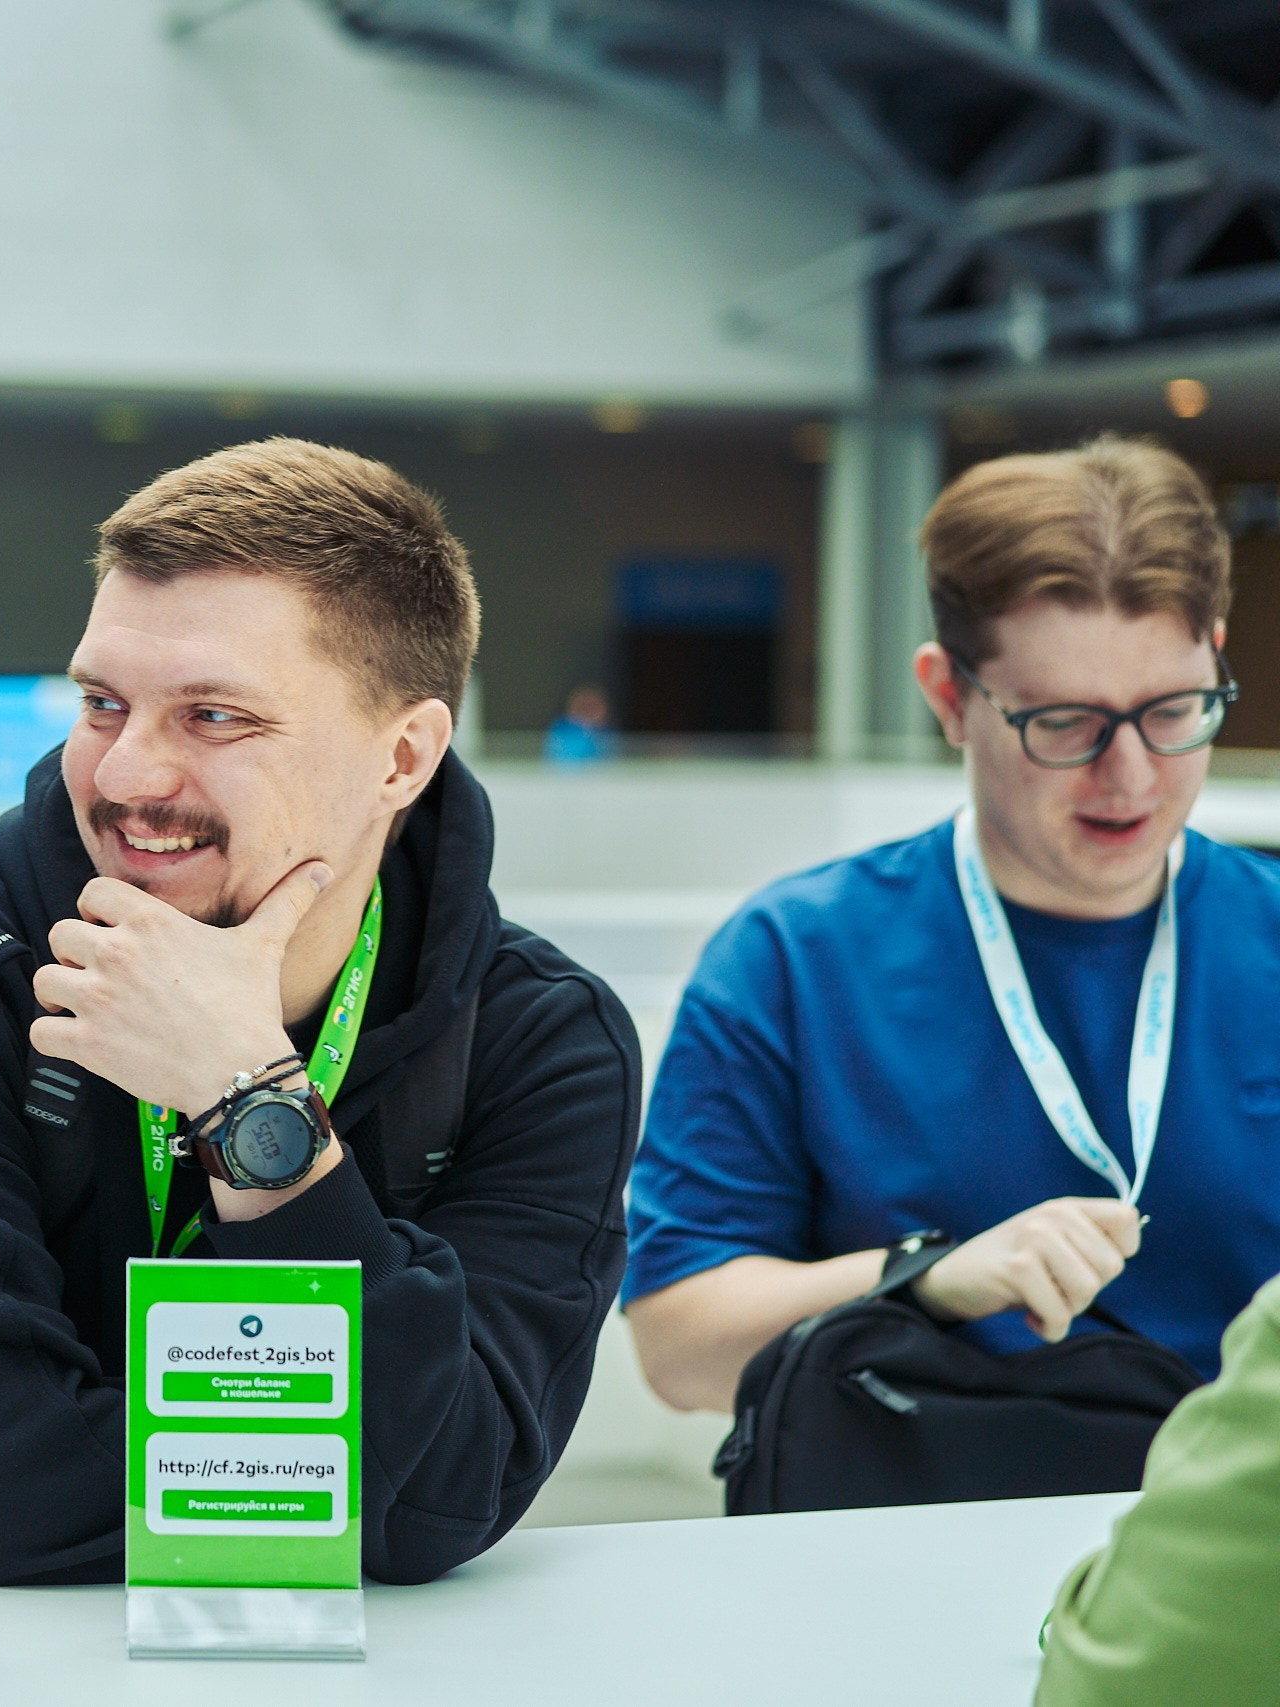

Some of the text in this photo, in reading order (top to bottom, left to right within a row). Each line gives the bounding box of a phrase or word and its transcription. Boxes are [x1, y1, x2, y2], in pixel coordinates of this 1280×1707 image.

[342, 968, 363, 1011] 2ГИС
[151, 1125, 165, 1172] 2ГИС
[167, 1346, 335, 1365] @codefest_2gis_bot
[211, 1377, 291, 1389] Смотри баланс
[221, 1390, 281, 1399] в кошельке
[159, 1459, 335, 1478] http://cf.2gis.ru/rega
[188, 1499, 304, 1513] Регистрируйся в игры
